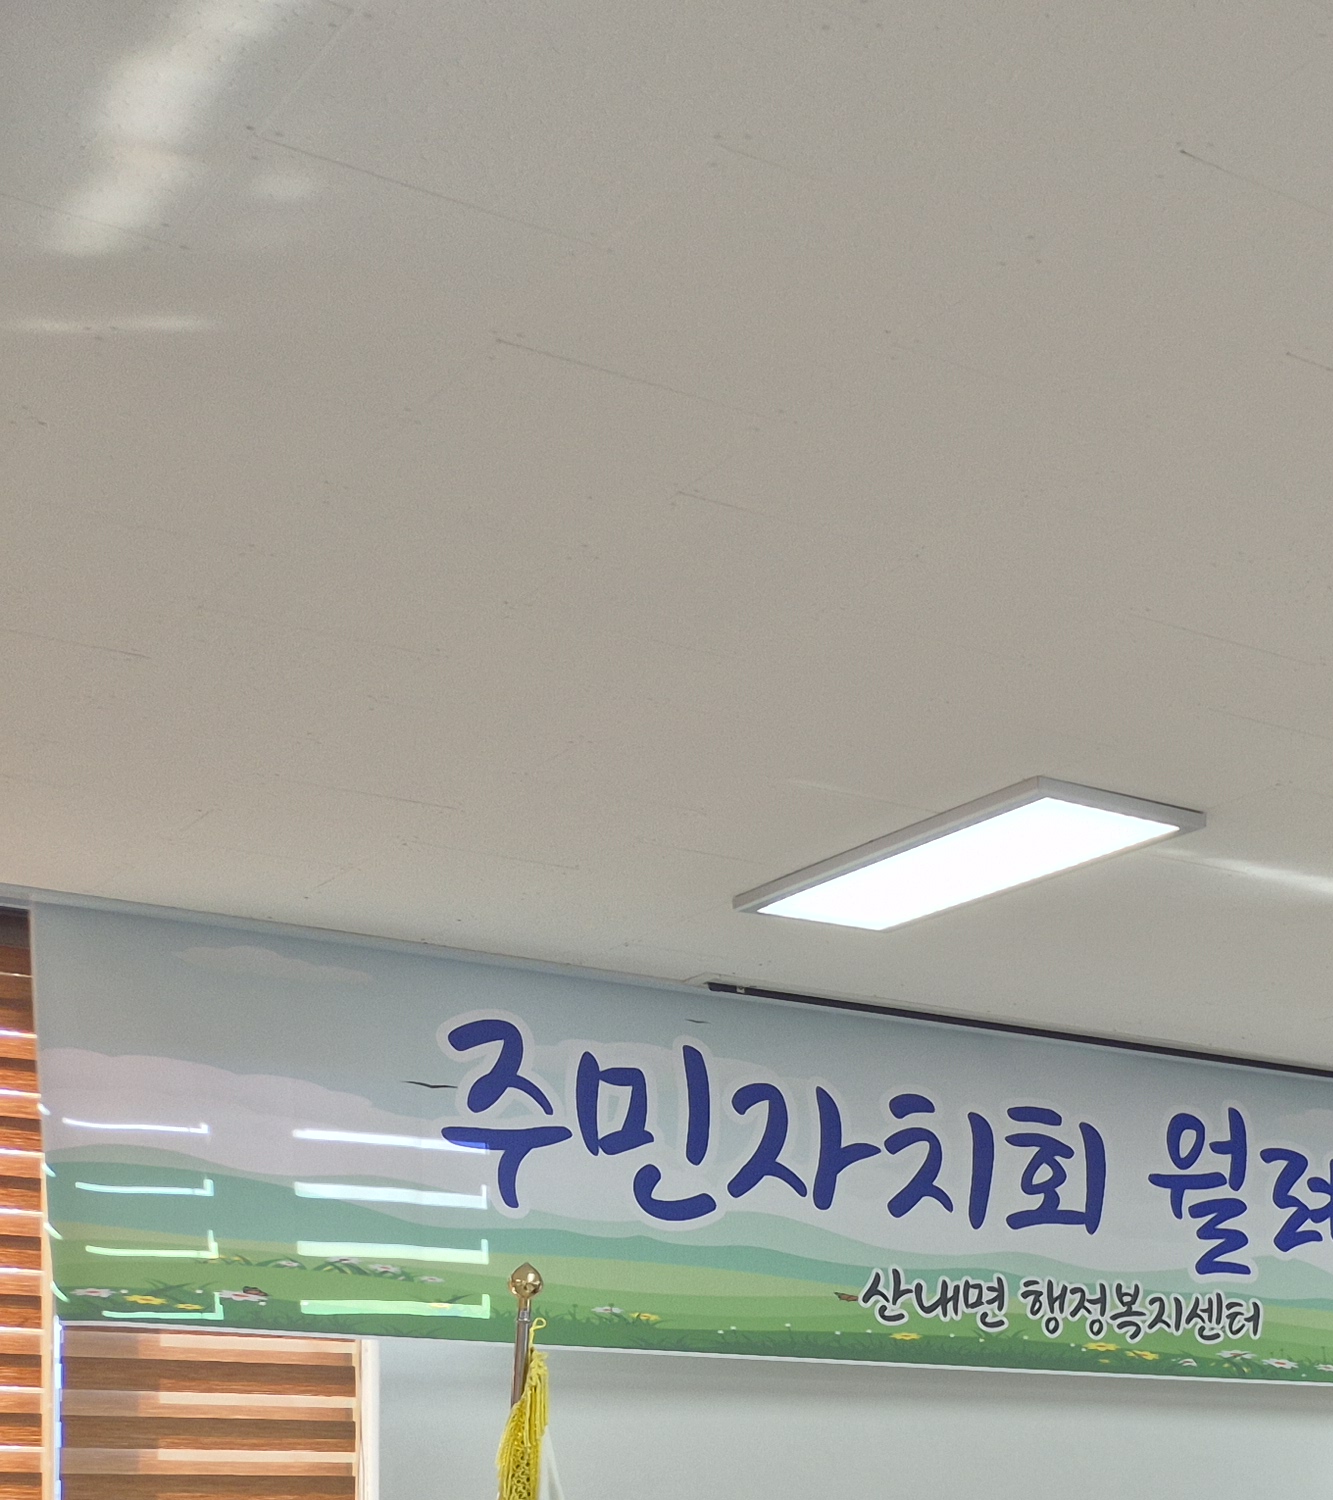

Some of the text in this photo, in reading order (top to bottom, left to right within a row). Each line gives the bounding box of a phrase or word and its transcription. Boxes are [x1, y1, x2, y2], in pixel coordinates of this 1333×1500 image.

[441, 1018, 1107, 1235] 주민자치회
[862, 1270, 1262, 1341] 산내면 행정복지센터
